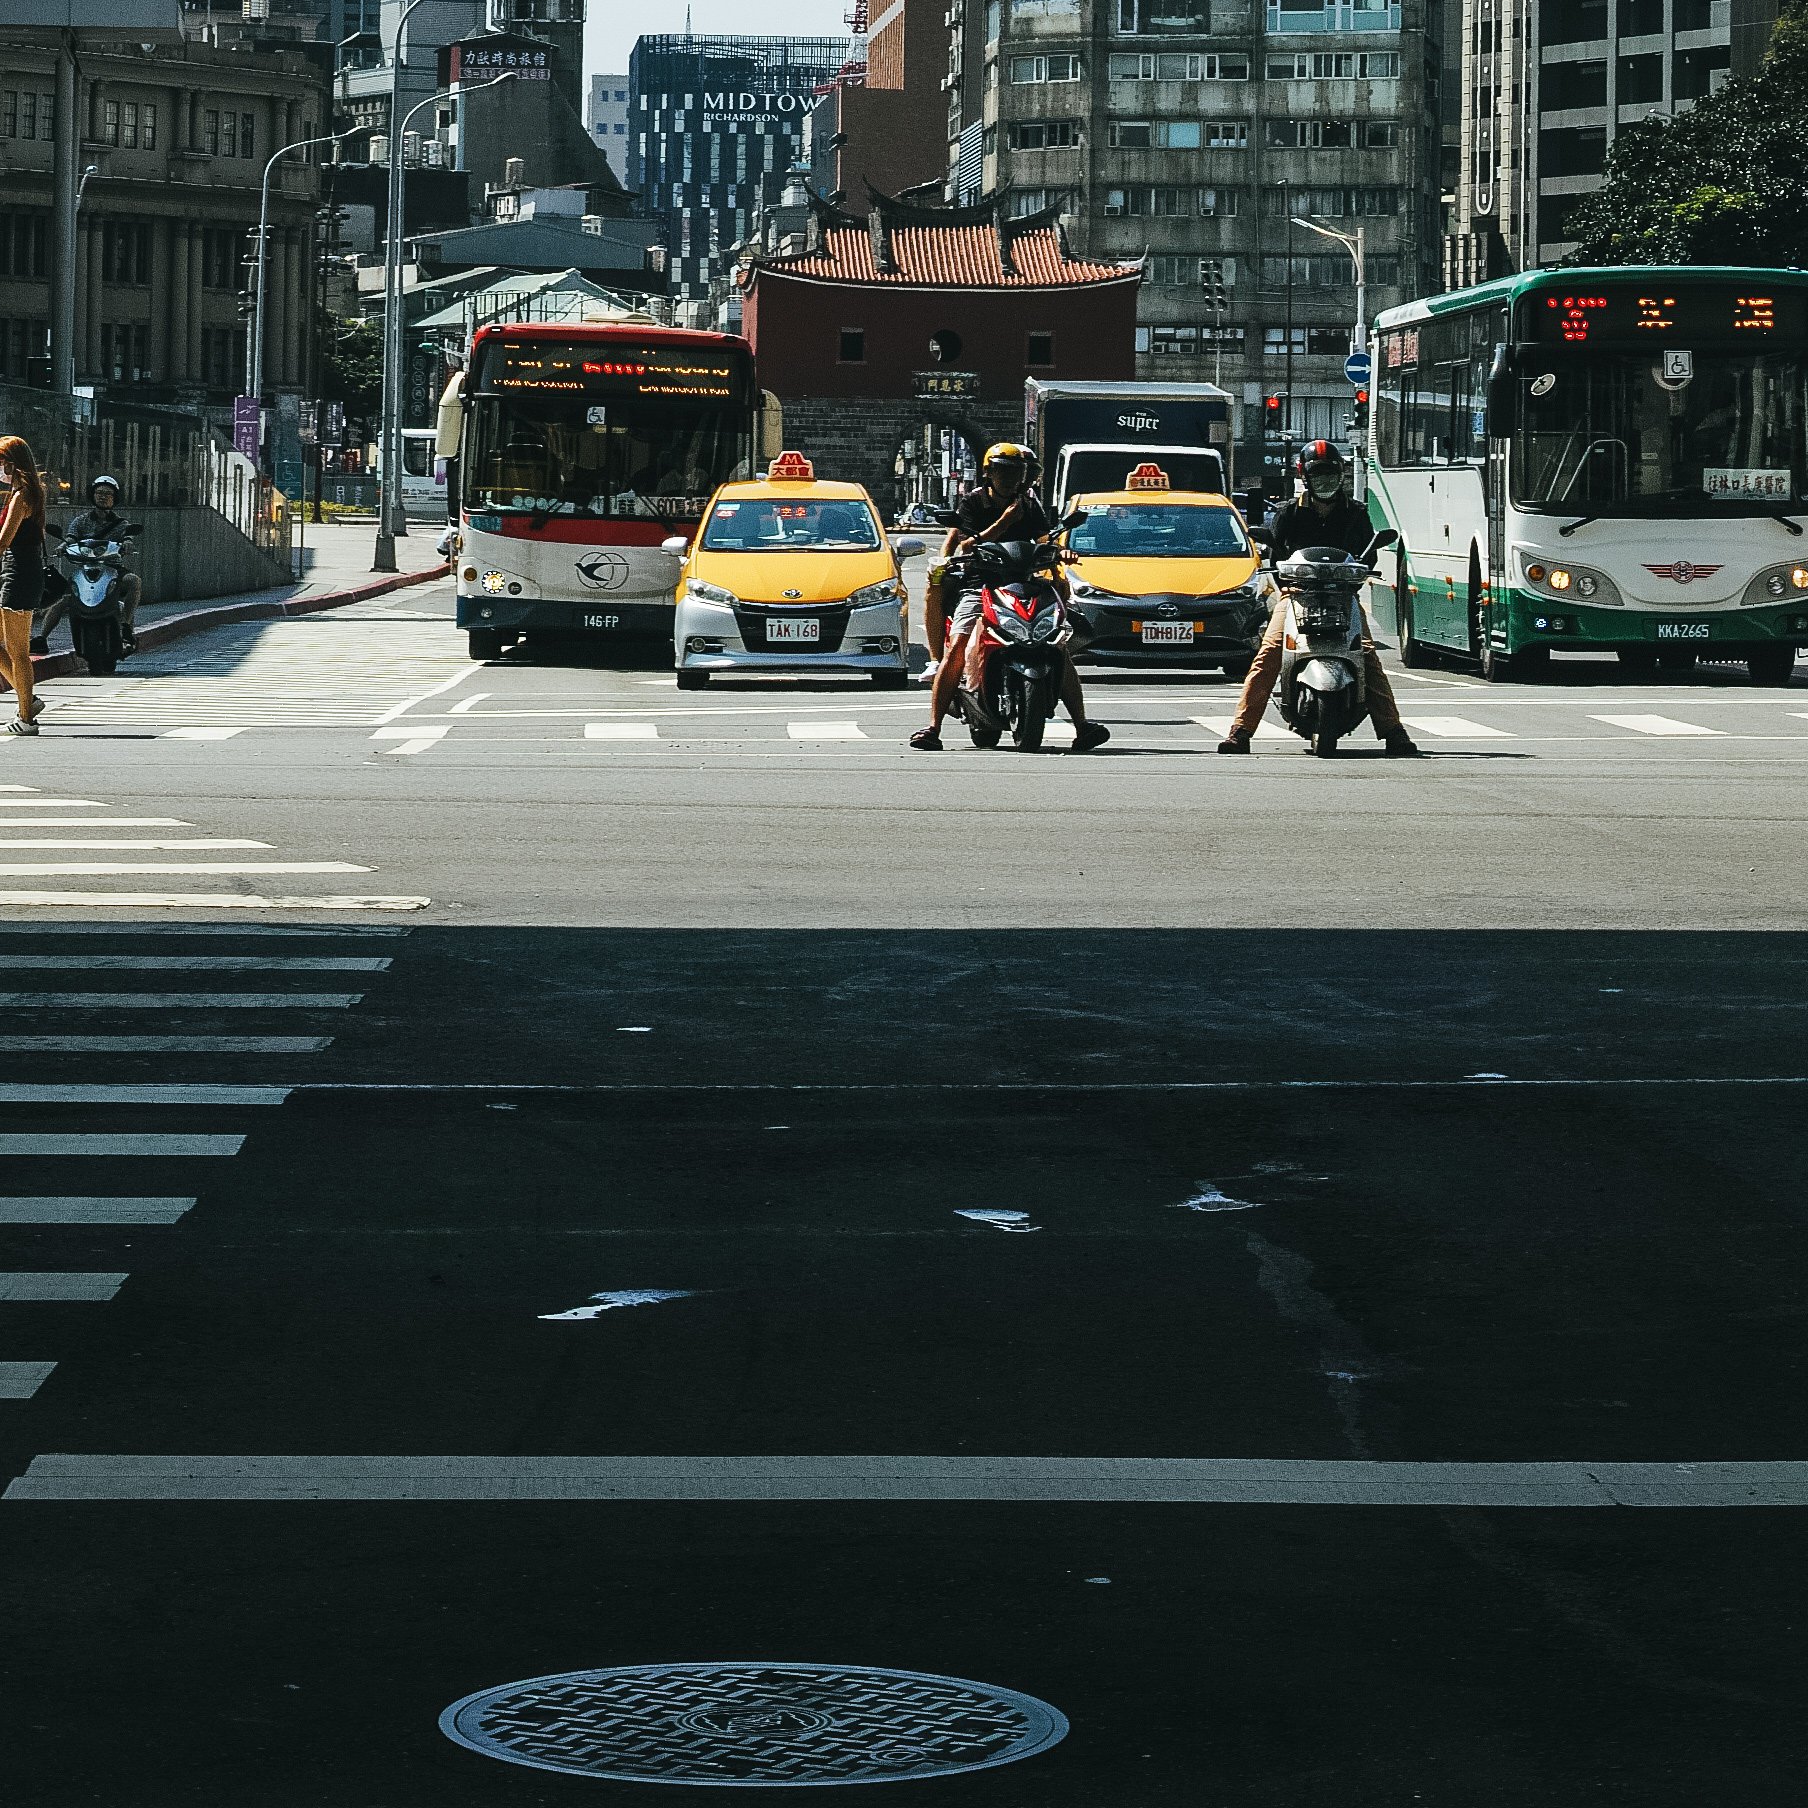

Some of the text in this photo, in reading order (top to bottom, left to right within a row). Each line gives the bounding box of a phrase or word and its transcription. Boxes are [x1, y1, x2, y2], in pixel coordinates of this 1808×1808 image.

[464, 51, 546, 66] 力歐時尚旅館
[704, 113, 779, 122] RICHARDSON
[784, 455, 798, 464] M
[772, 466, 810, 477] 大都會
[1142, 466, 1155, 476] M
[1708, 474, 1786, 495] 往林口長庚醫院
[584, 615, 619, 628] 146-FP
[768, 623, 818, 638] TAK-168
[1143, 626, 1193, 640] TDH-8126
[1658, 624, 1710, 638] KKA-2665
